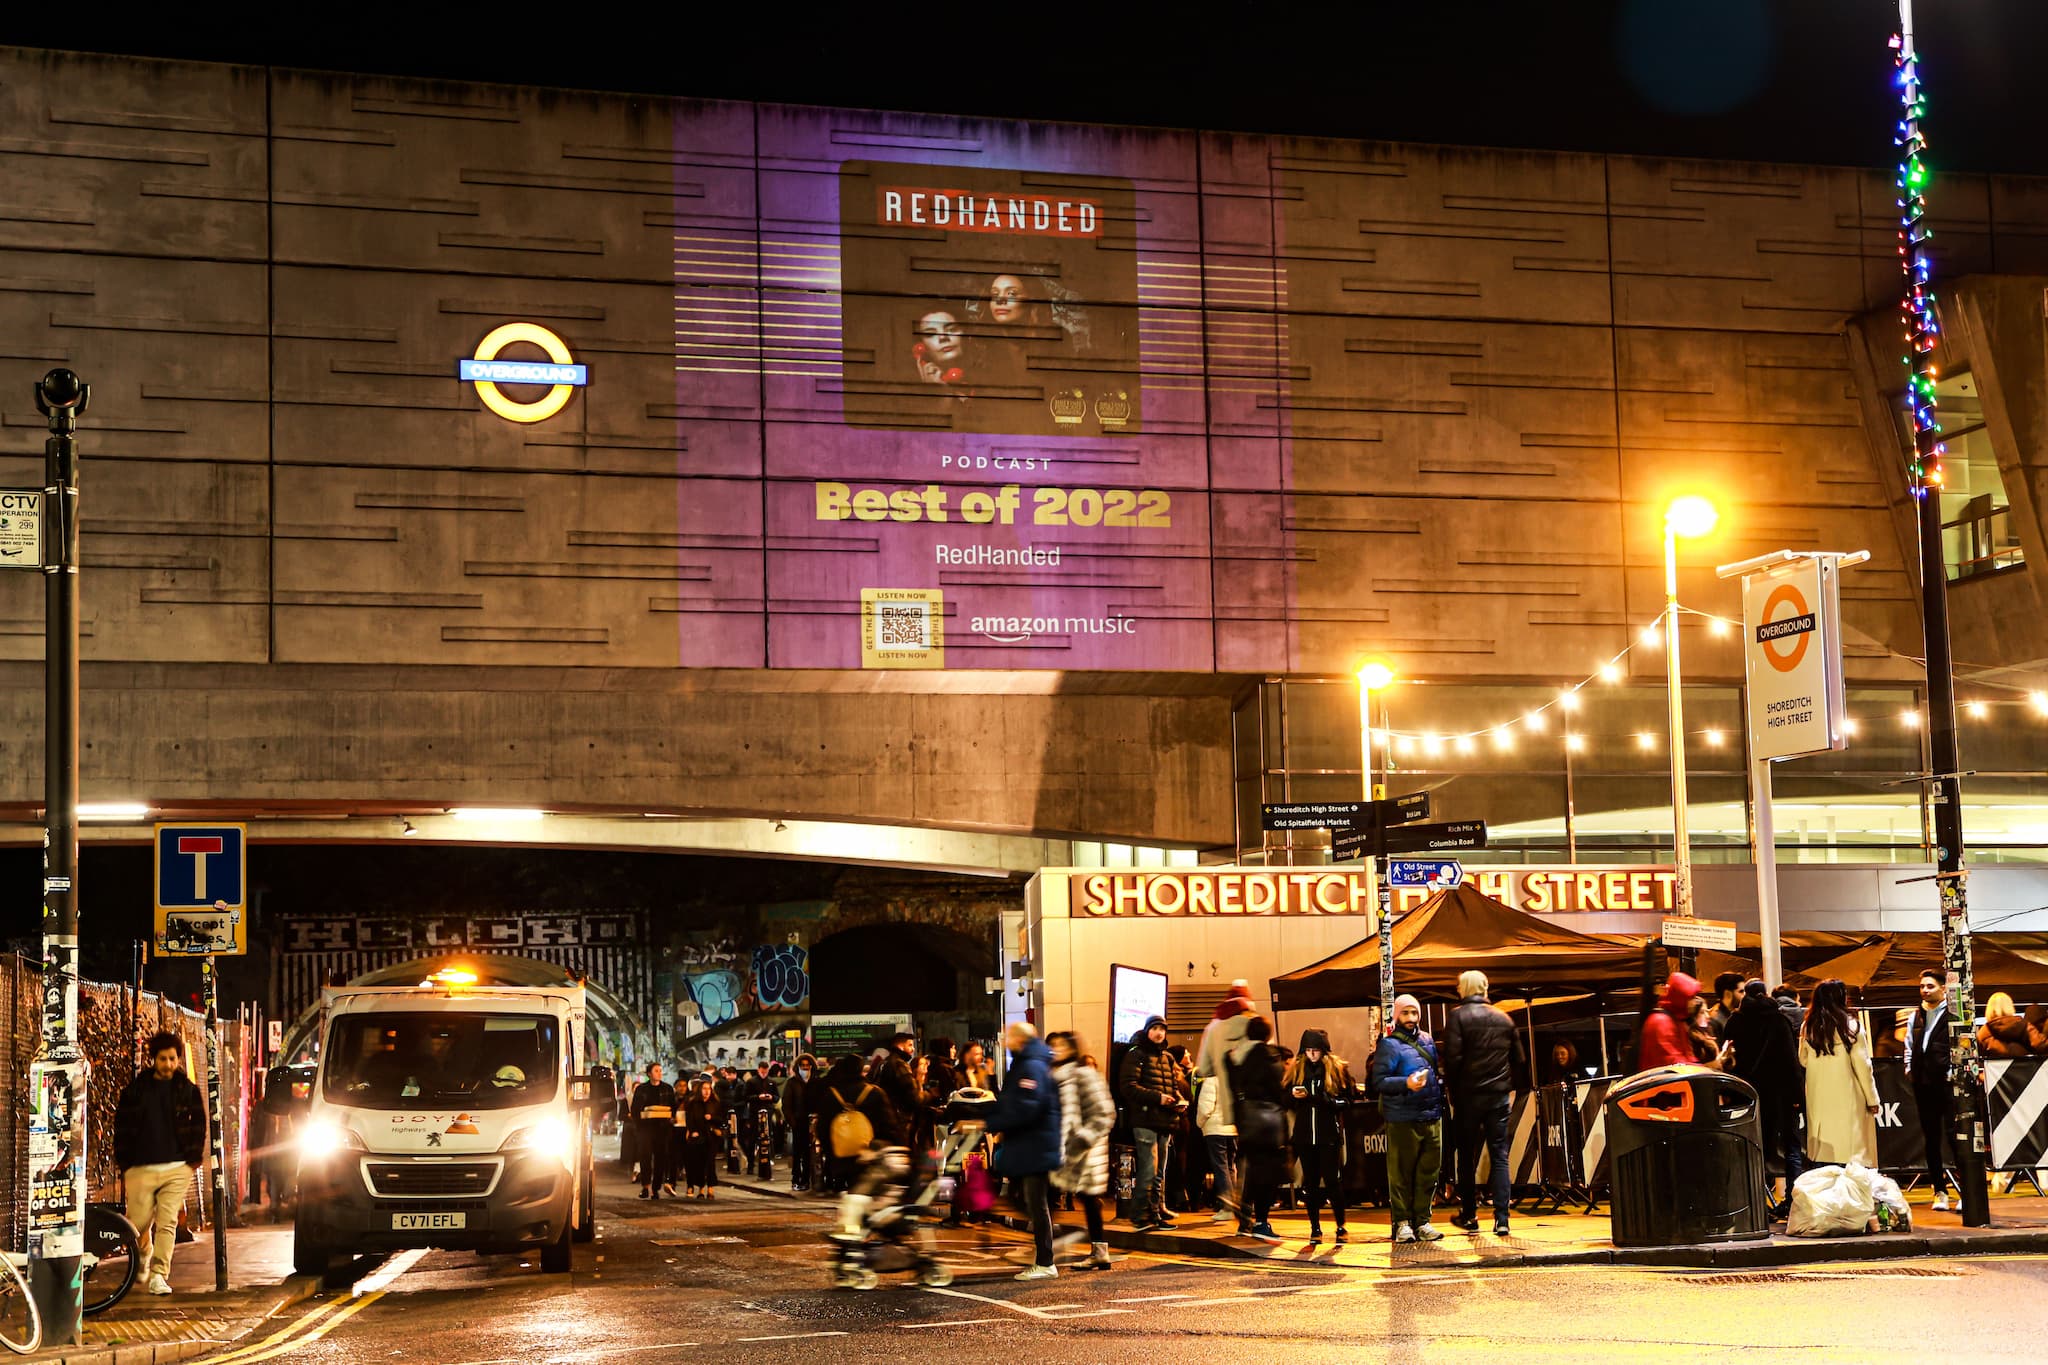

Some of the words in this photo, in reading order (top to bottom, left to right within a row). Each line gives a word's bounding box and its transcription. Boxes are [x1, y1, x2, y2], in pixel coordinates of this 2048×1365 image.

[885, 191, 1096, 233] REDHANDED
[470, 363, 577, 381] OVERGROUND
[941, 455, 1051, 471] PODCAST
[815, 481, 947, 523] Best
[960, 484, 1021, 525] of
[1033, 488, 1171, 527] 2022
[19, 521, 34, 530] 299
[936, 544, 1061, 567] RedHanded
[865, 600, 873, 616] APP
[971, 616, 1060, 635] amazon
[1065, 613, 1136, 634] music
[1760, 617, 1812, 639] OVERGROUND
[1767, 696, 1812, 714] SHOREDITCH
[1767, 716, 1786, 728] HIGH
[1787, 712, 1812, 725] STREET
[1273, 806, 1310, 814] Shoreditch
[1311, 806, 1327, 814] High
[1328, 804, 1349, 812] Street
[1288, 819, 1326, 828] Spitalfields
[1326, 818, 1351, 826] Market
[1429, 839, 1458, 848] Columbia
[1458, 838, 1475, 846] Road
[1403, 863, 1415, 871] Old
[1416, 863, 1436, 871] Street
[1526, 872, 1677, 911] STREET
[33, 1185, 71, 1199] PRICE
[32, 1199, 46, 1211] OF
[48, 1197, 71, 1209] OIL
[400, 1215, 429, 1228] CV71
[433, 1214, 458, 1227] EFL
